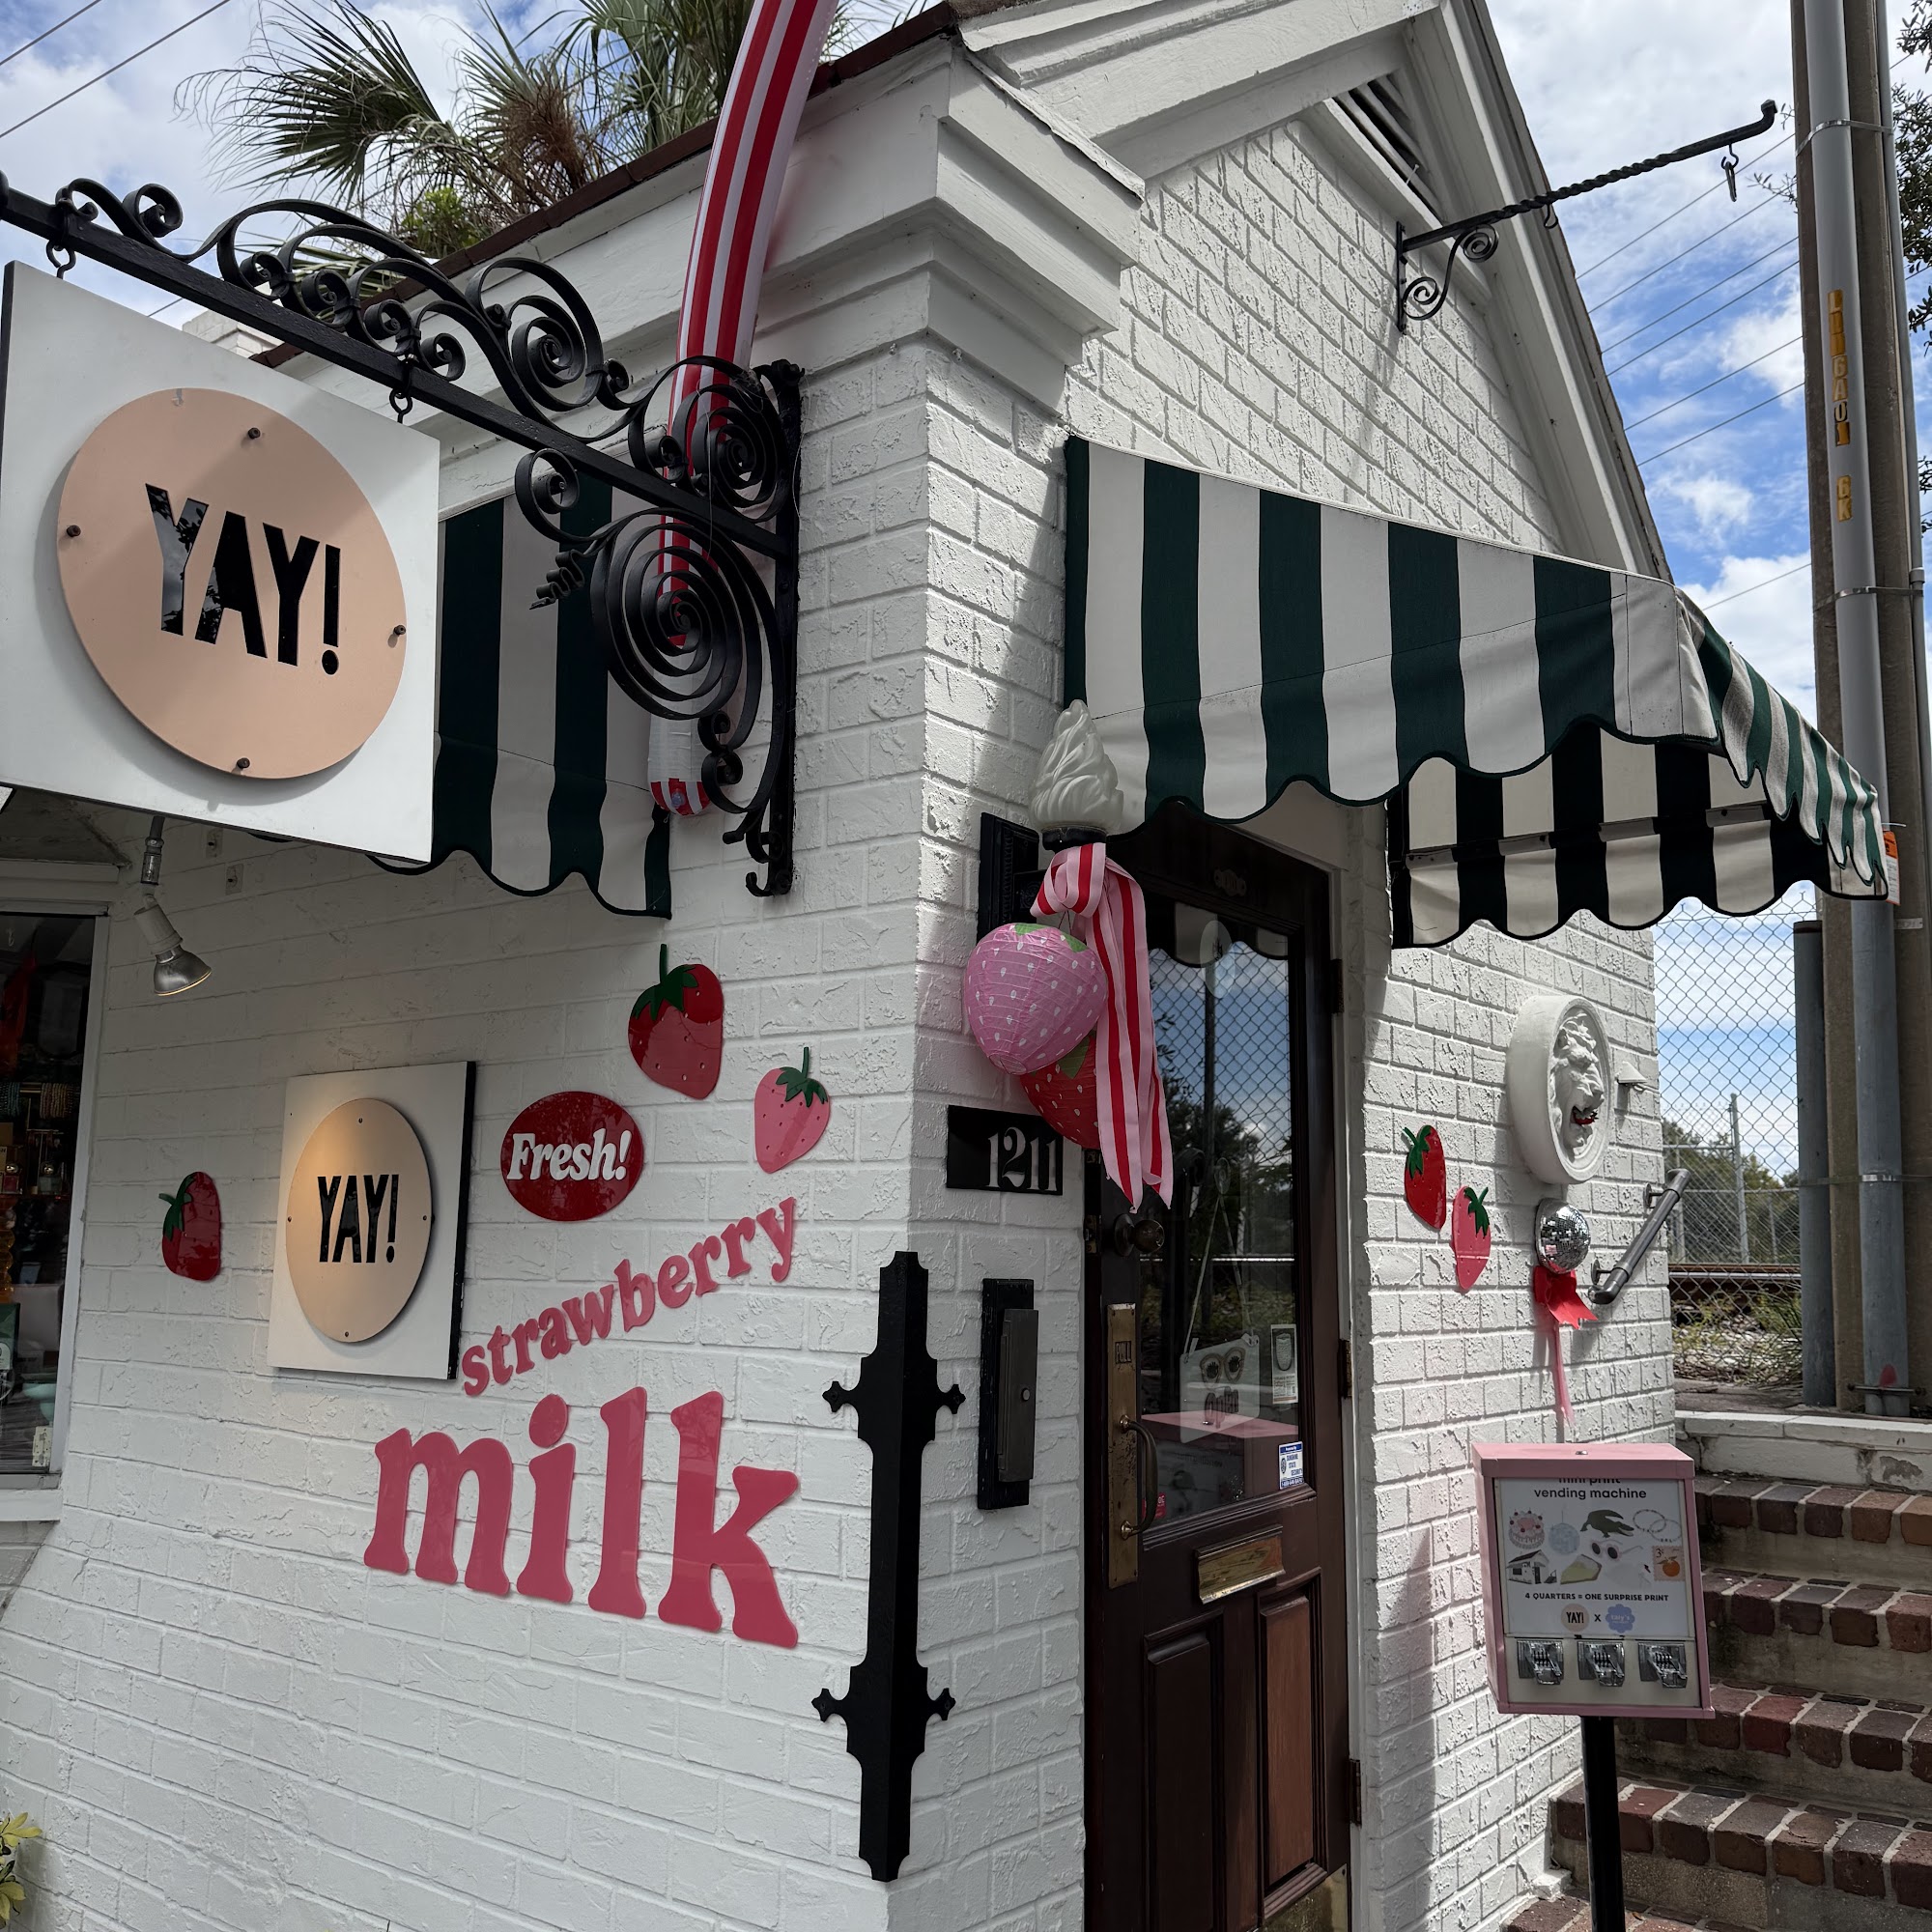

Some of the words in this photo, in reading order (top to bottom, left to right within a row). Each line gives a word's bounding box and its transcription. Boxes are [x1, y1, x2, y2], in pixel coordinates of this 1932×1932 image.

[145, 483, 341, 675] YAY!
[506, 1128, 633, 1181] Fresh!
[984, 1126, 1058, 1191] 1211
[318, 1174, 399, 1264] YAY!
[461, 1196, 796, 1395] strawberry
[1116, 1342, 1131, 1363] PULL
[363, 1386, 798, 1649] milk
[1534, 1488, 1586, 1500] vending
[1590, 1488, 1647, 1498] machine
[1566, 1611, 1584, 1624] YAY!
